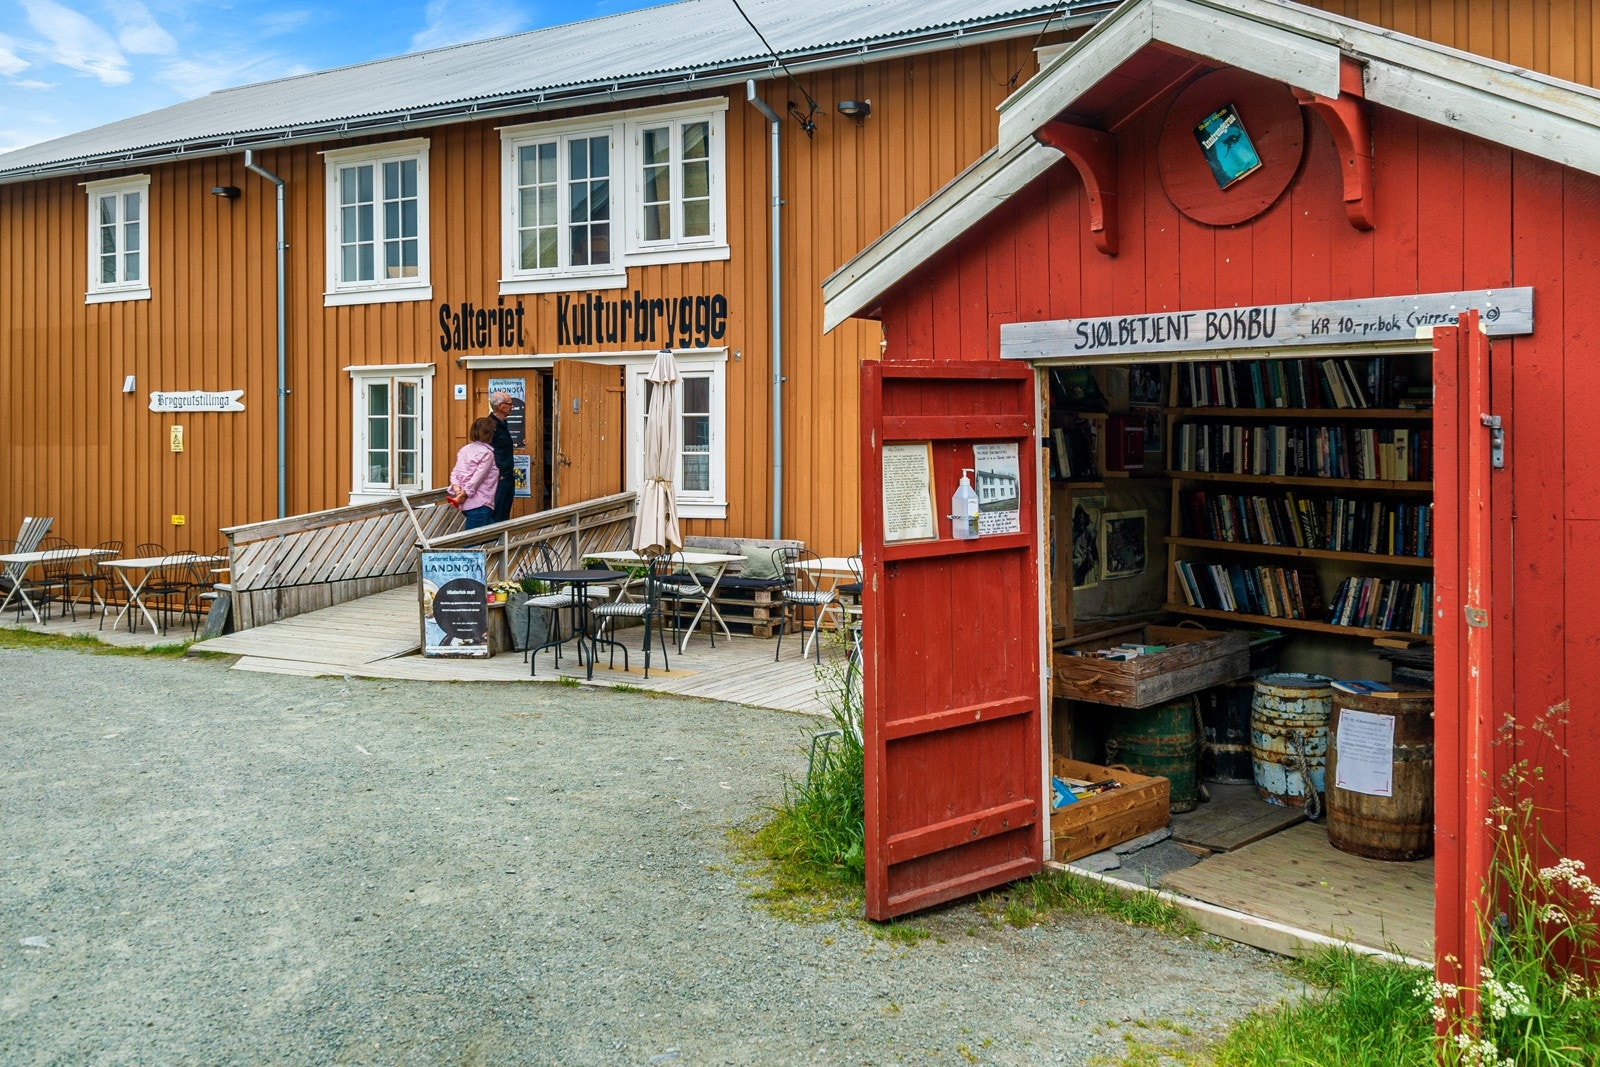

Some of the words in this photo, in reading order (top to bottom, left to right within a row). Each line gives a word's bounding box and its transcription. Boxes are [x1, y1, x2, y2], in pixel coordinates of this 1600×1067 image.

[439, 297, 525, 352] Salteriet
[558, 290, 727, 349] Kulturbrygge
[1074, 313, 1197, 350] SJØLBETJENT
[1205, 306, 1277, 343] BOKBU
[1311, 317, 1330, 335] KR
[424, 563, 483, 573] LANDNOTA
